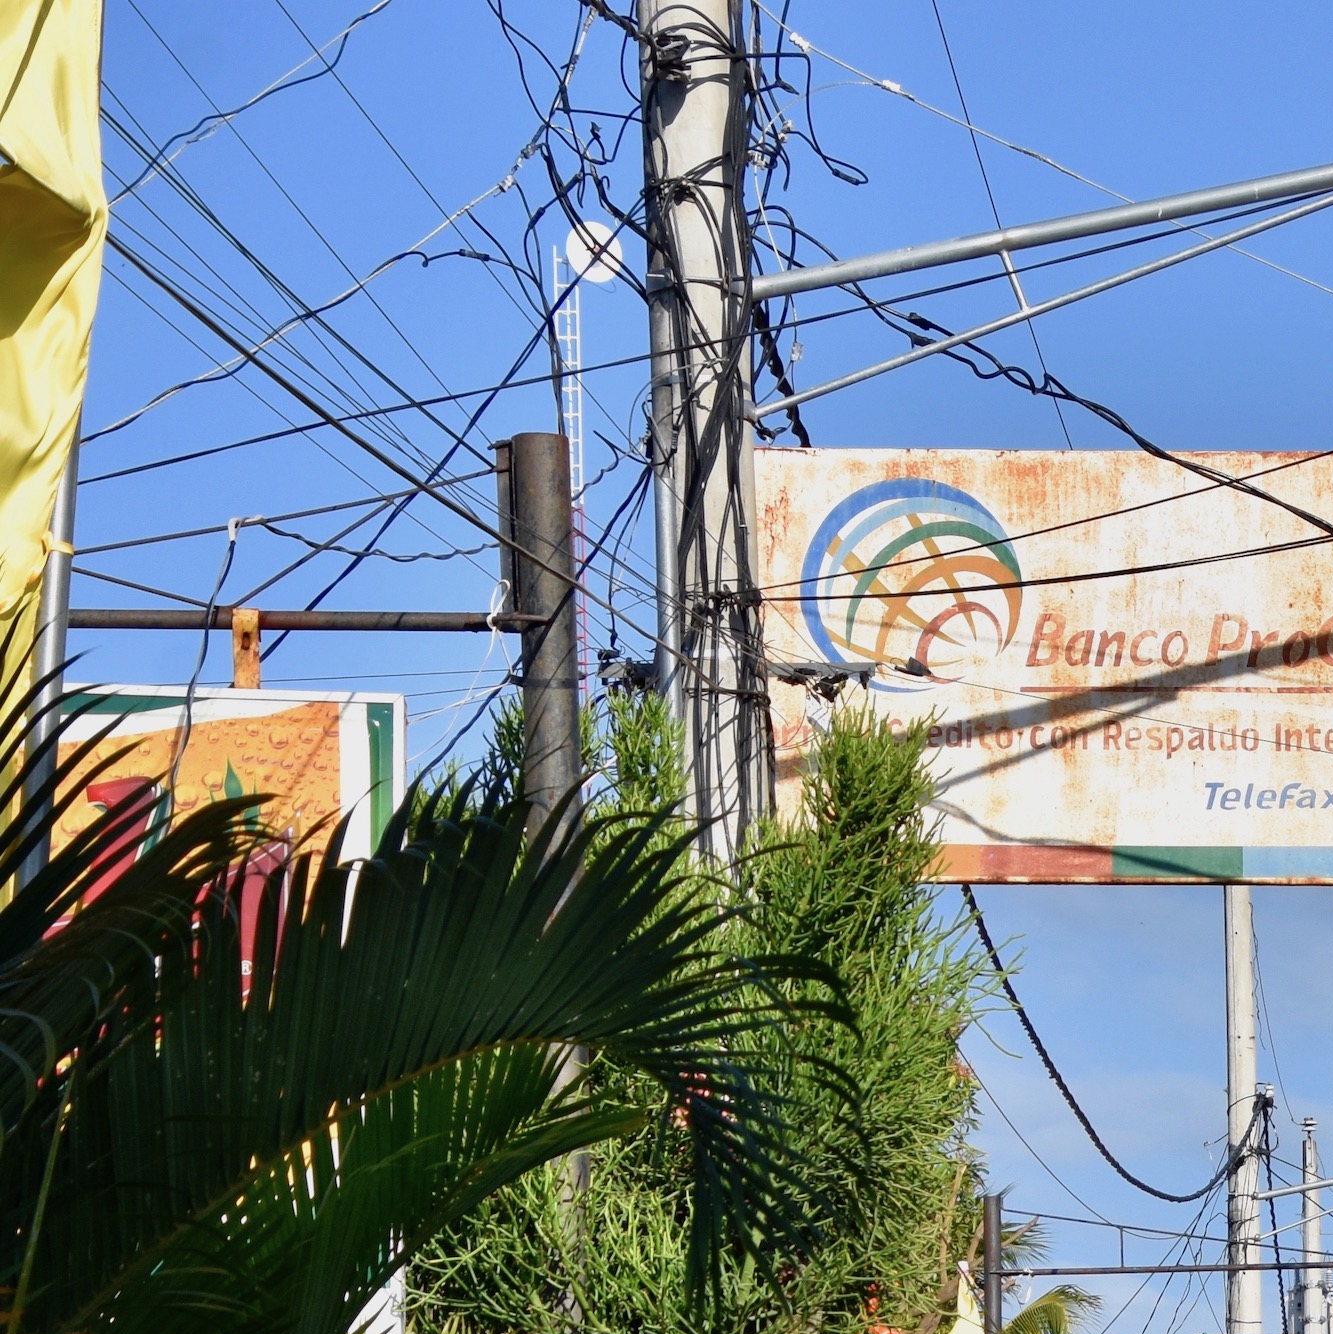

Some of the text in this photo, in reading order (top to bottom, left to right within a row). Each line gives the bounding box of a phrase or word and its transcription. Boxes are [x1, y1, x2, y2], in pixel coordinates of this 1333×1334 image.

[1025, 611, 1190, 669] Banco
[1028, 722, 1089, 751] con
[1103, 720, 1261, 760] Respaldo
